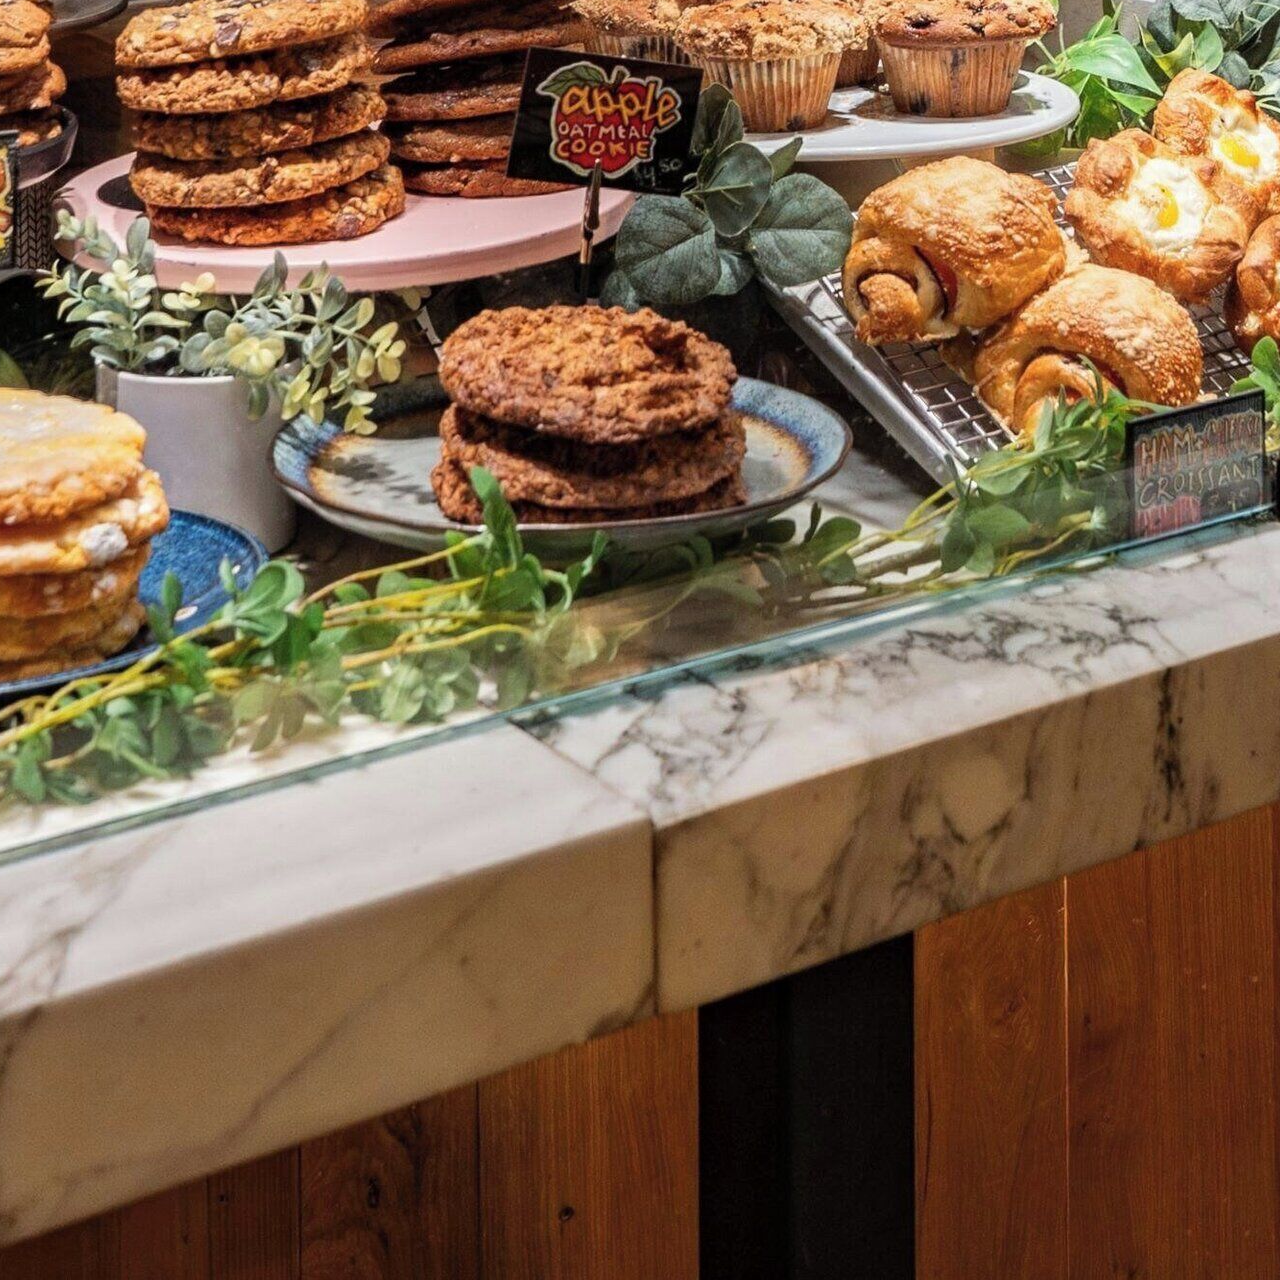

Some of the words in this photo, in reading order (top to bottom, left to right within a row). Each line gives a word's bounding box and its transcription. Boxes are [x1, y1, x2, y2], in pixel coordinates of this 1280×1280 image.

[561, 79, 677, 127] apple
[556, 140, 650, 157] COOKIE
[558, 121, 648, 140] OATMEAL
[1140, 423, 1195, 466] HAM
[1140, 455, 1259, 507] CROISSANT
